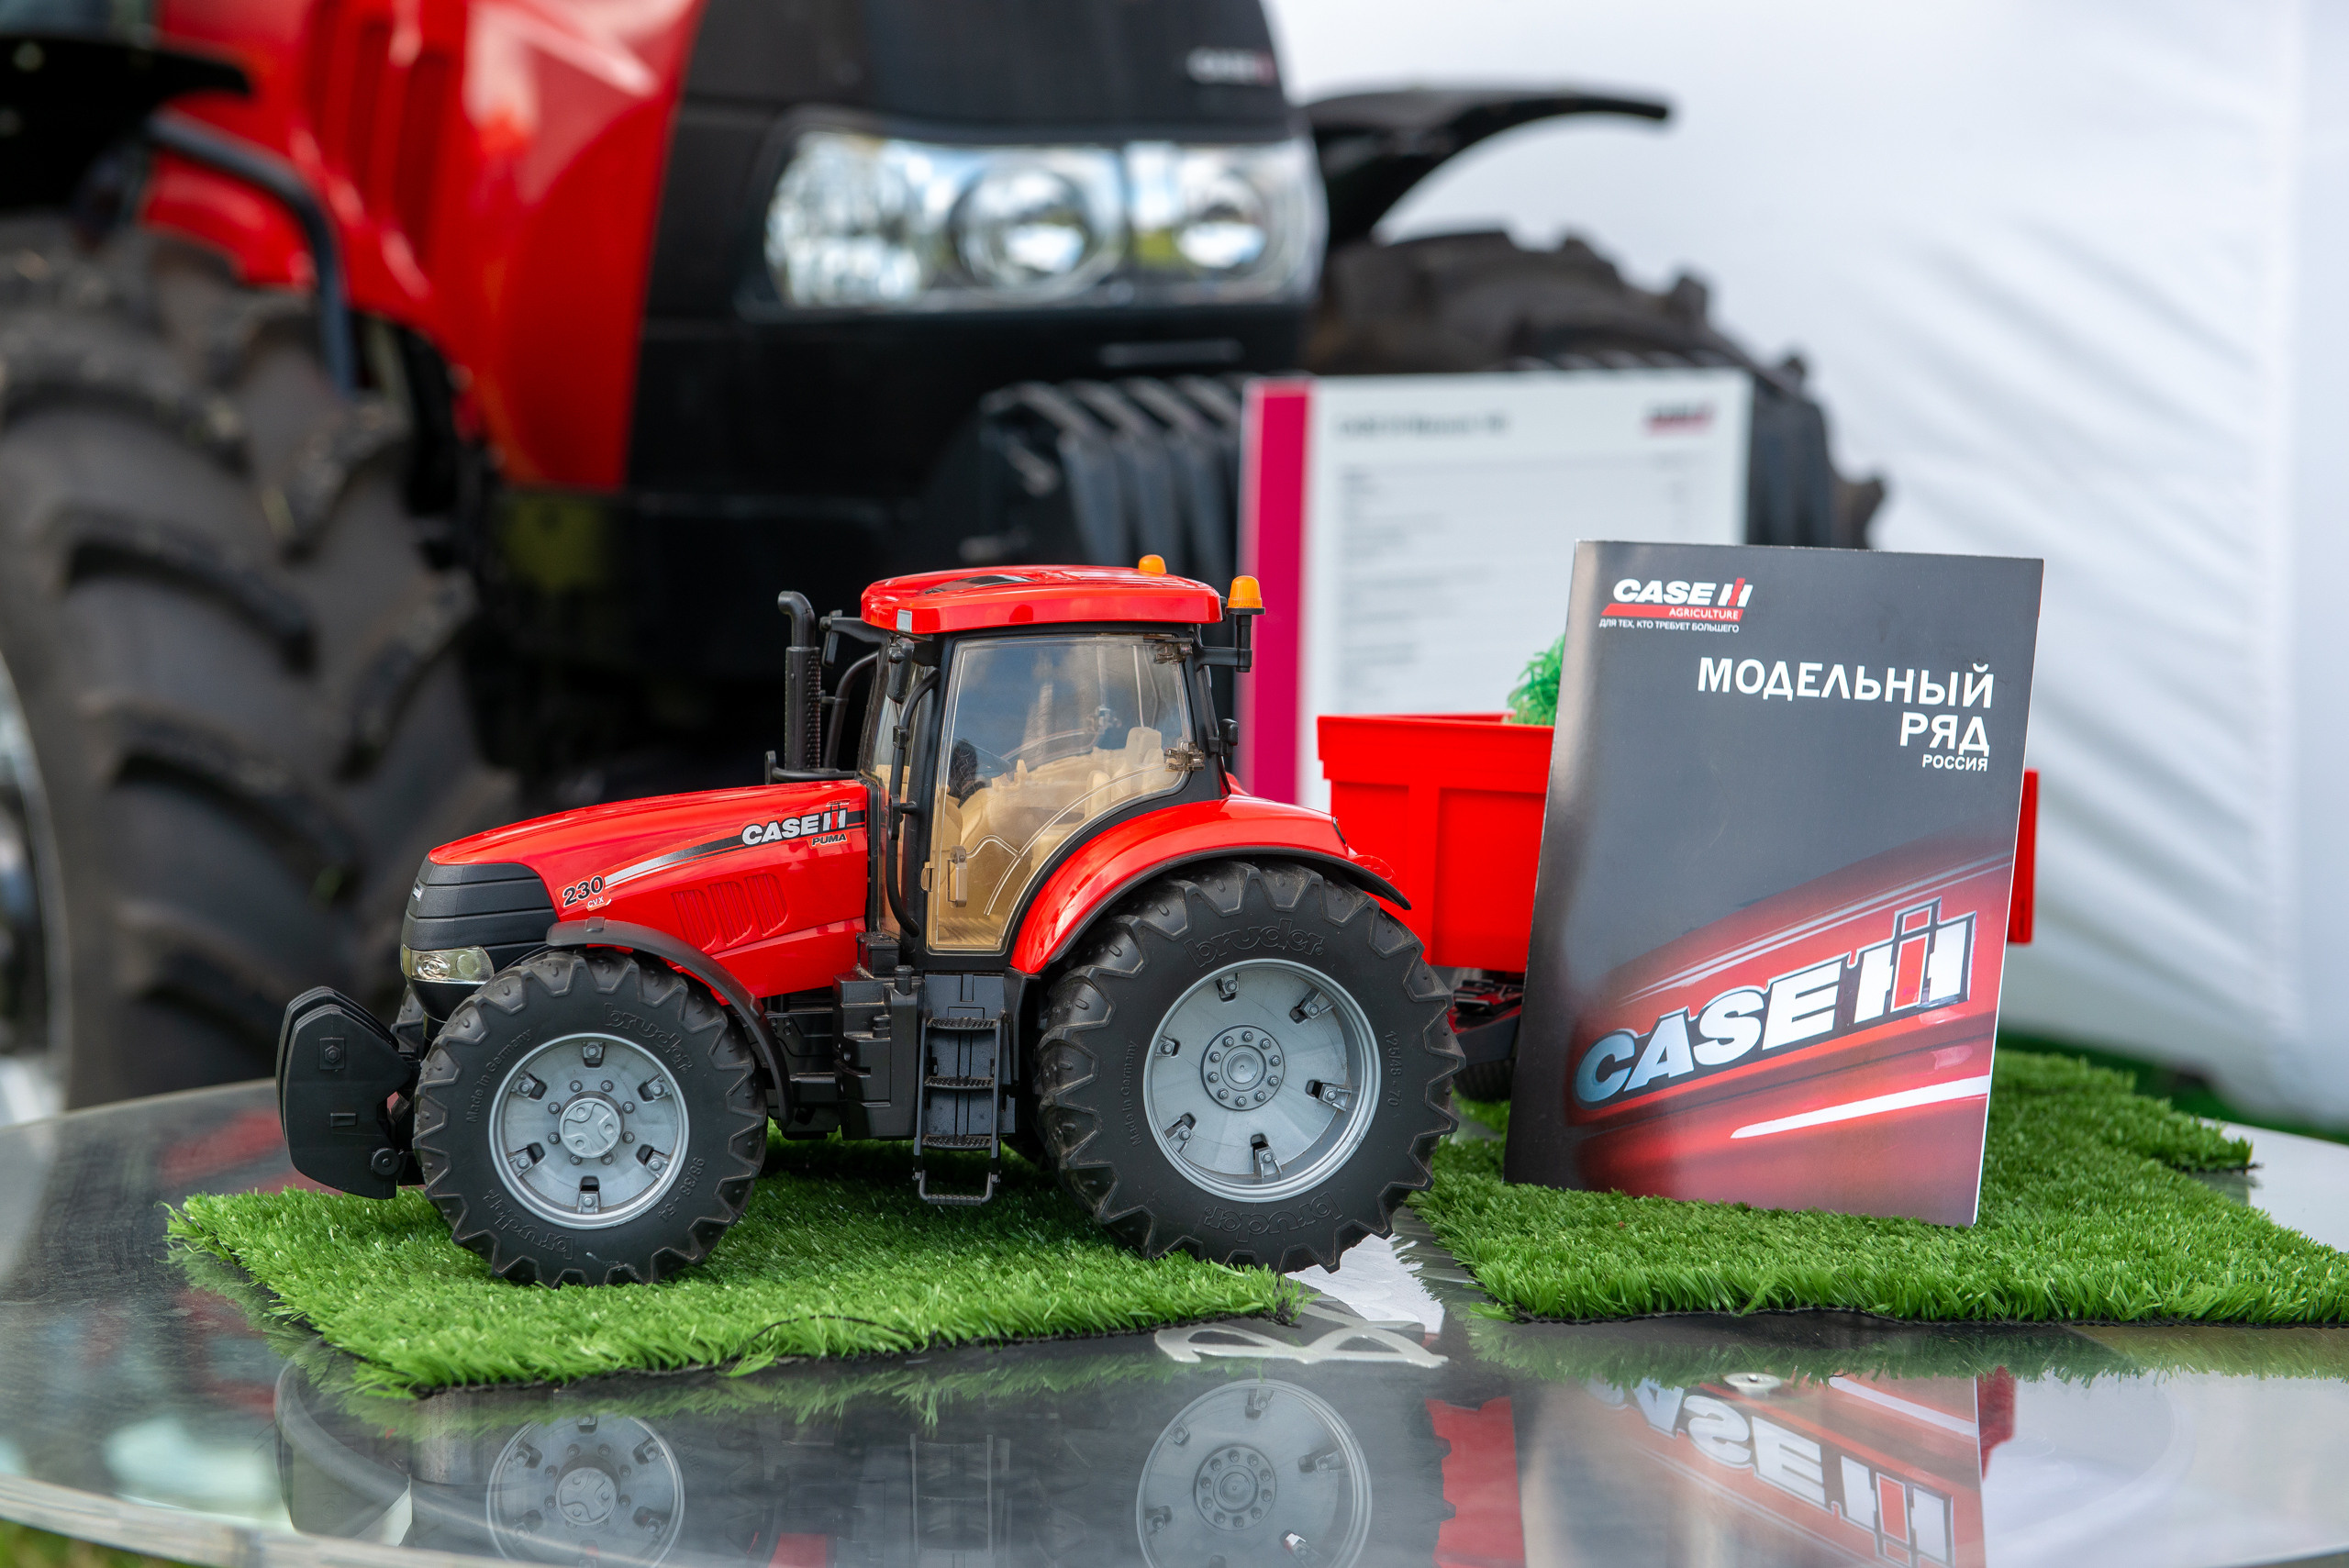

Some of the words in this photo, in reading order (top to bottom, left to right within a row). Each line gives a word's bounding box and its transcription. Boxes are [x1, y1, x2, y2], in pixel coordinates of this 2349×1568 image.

[1613, 578, 1717, 606] CASE
[1598, 618, 1617, 628] ДЛЯ
[1636, 620, 1653, 629] КТО
[1655, 621, 1690, 631] ТРЕБУЕТ
[1691, 622, 1740, 633] БОЛЬШЕГО
[1669, 607, 1739, 620] AGRICULTURE
[1698, 657, 1995, 708] МОДЕЛЬНЫЙ
[1899, 711, 1990, 757] РЯД
[1921, 754, 1989, 773] РОССИЯ
[741, 814, 819, 845] CASE
[811, 833, 847, 847] PUMA
[562, 875, 604, 907] 230
[587, 895, 605, 907] CVX
[1574, 959, 1842, 1103] CASE
[485, 1029, 532, 1073] Germany
[473, 1074, 491, 1086] in
[1120, 1040, 1139, 1096] Germany
[465, 1089, 484, 1122] Made
[1125, 1113, 1142, 1148] Made
